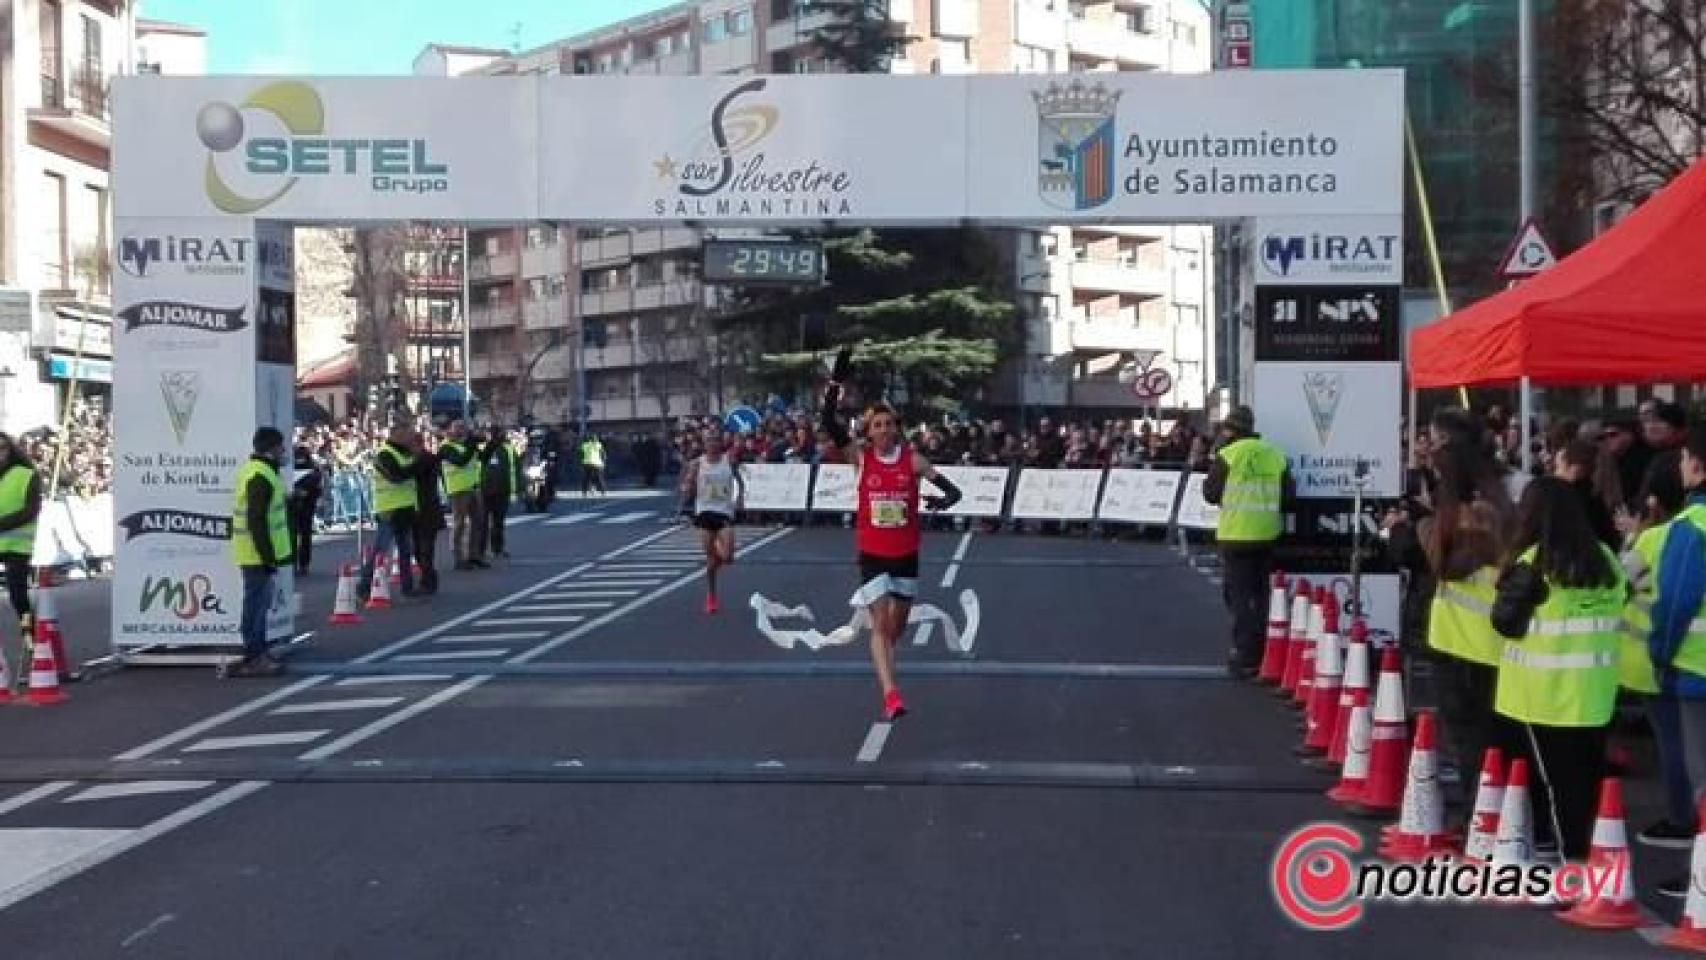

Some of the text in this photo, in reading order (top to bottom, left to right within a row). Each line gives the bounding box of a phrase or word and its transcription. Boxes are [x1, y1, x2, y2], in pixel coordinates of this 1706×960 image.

[679, 78, 850, 196] Silvestre
[1123, 129, 1338, 165] Ayuntamiento
[245, 137, 448, 175] SETEL
[372, 176, 448, 194] Grupo
[1124, 166, 1337, 194] de Salamanca
[654, 199, 851, 215] SALMANTINA
[140, 305, 228, 328] ALJOMAR
[123, 453, 153, 467] San
[141, 471, 220, 485] de Kostka
[141, 514, 229, 536] ALJOMAR
